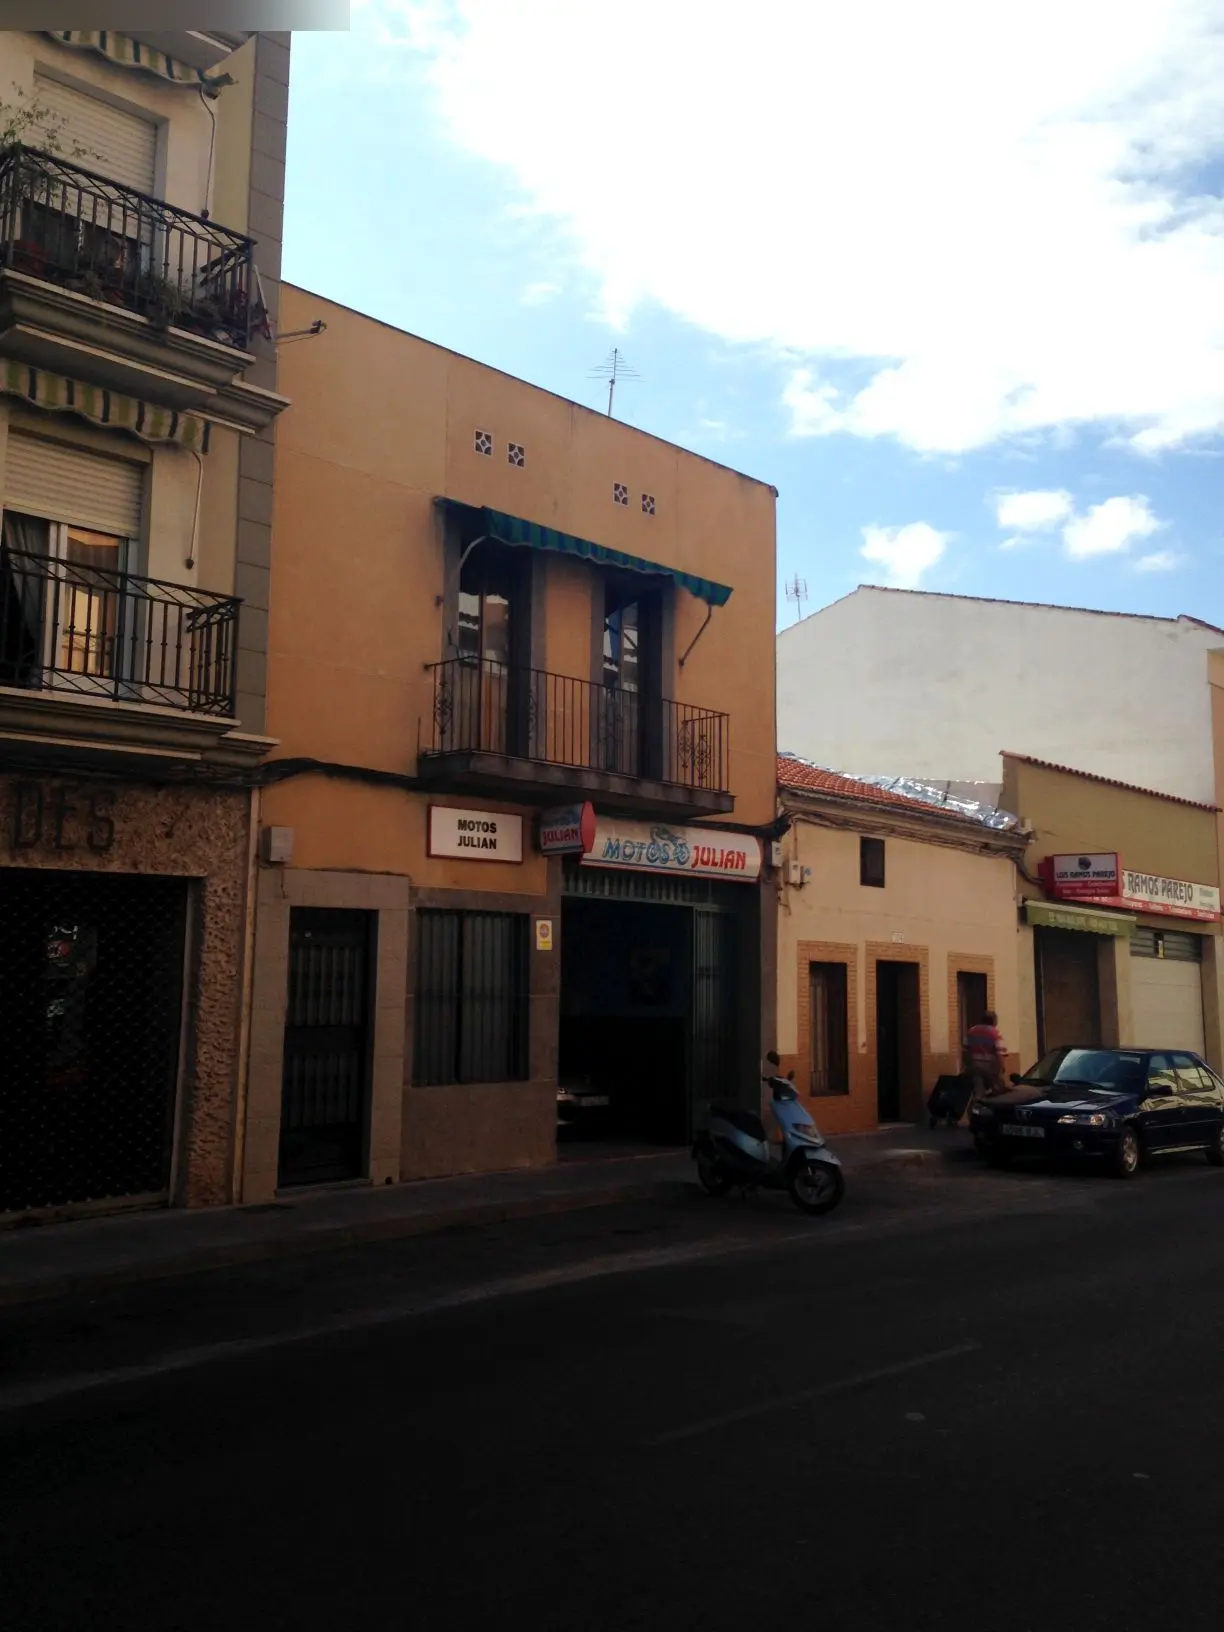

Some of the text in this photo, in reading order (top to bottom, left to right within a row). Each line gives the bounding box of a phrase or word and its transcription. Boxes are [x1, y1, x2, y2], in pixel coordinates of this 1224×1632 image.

[457, 819, 497, 834] MOTOS
[543, 821, 580, 846] JULIAN
[457, 835, 497, 850] JULIAN
[603, 838, 747, 871] MOTOS JULIAN
[1092, 870, 1115, 879] PAREJO
[1127, 873, 1159, 896] RAMOS
[1161, 879, 1194, 904] PAREJO
